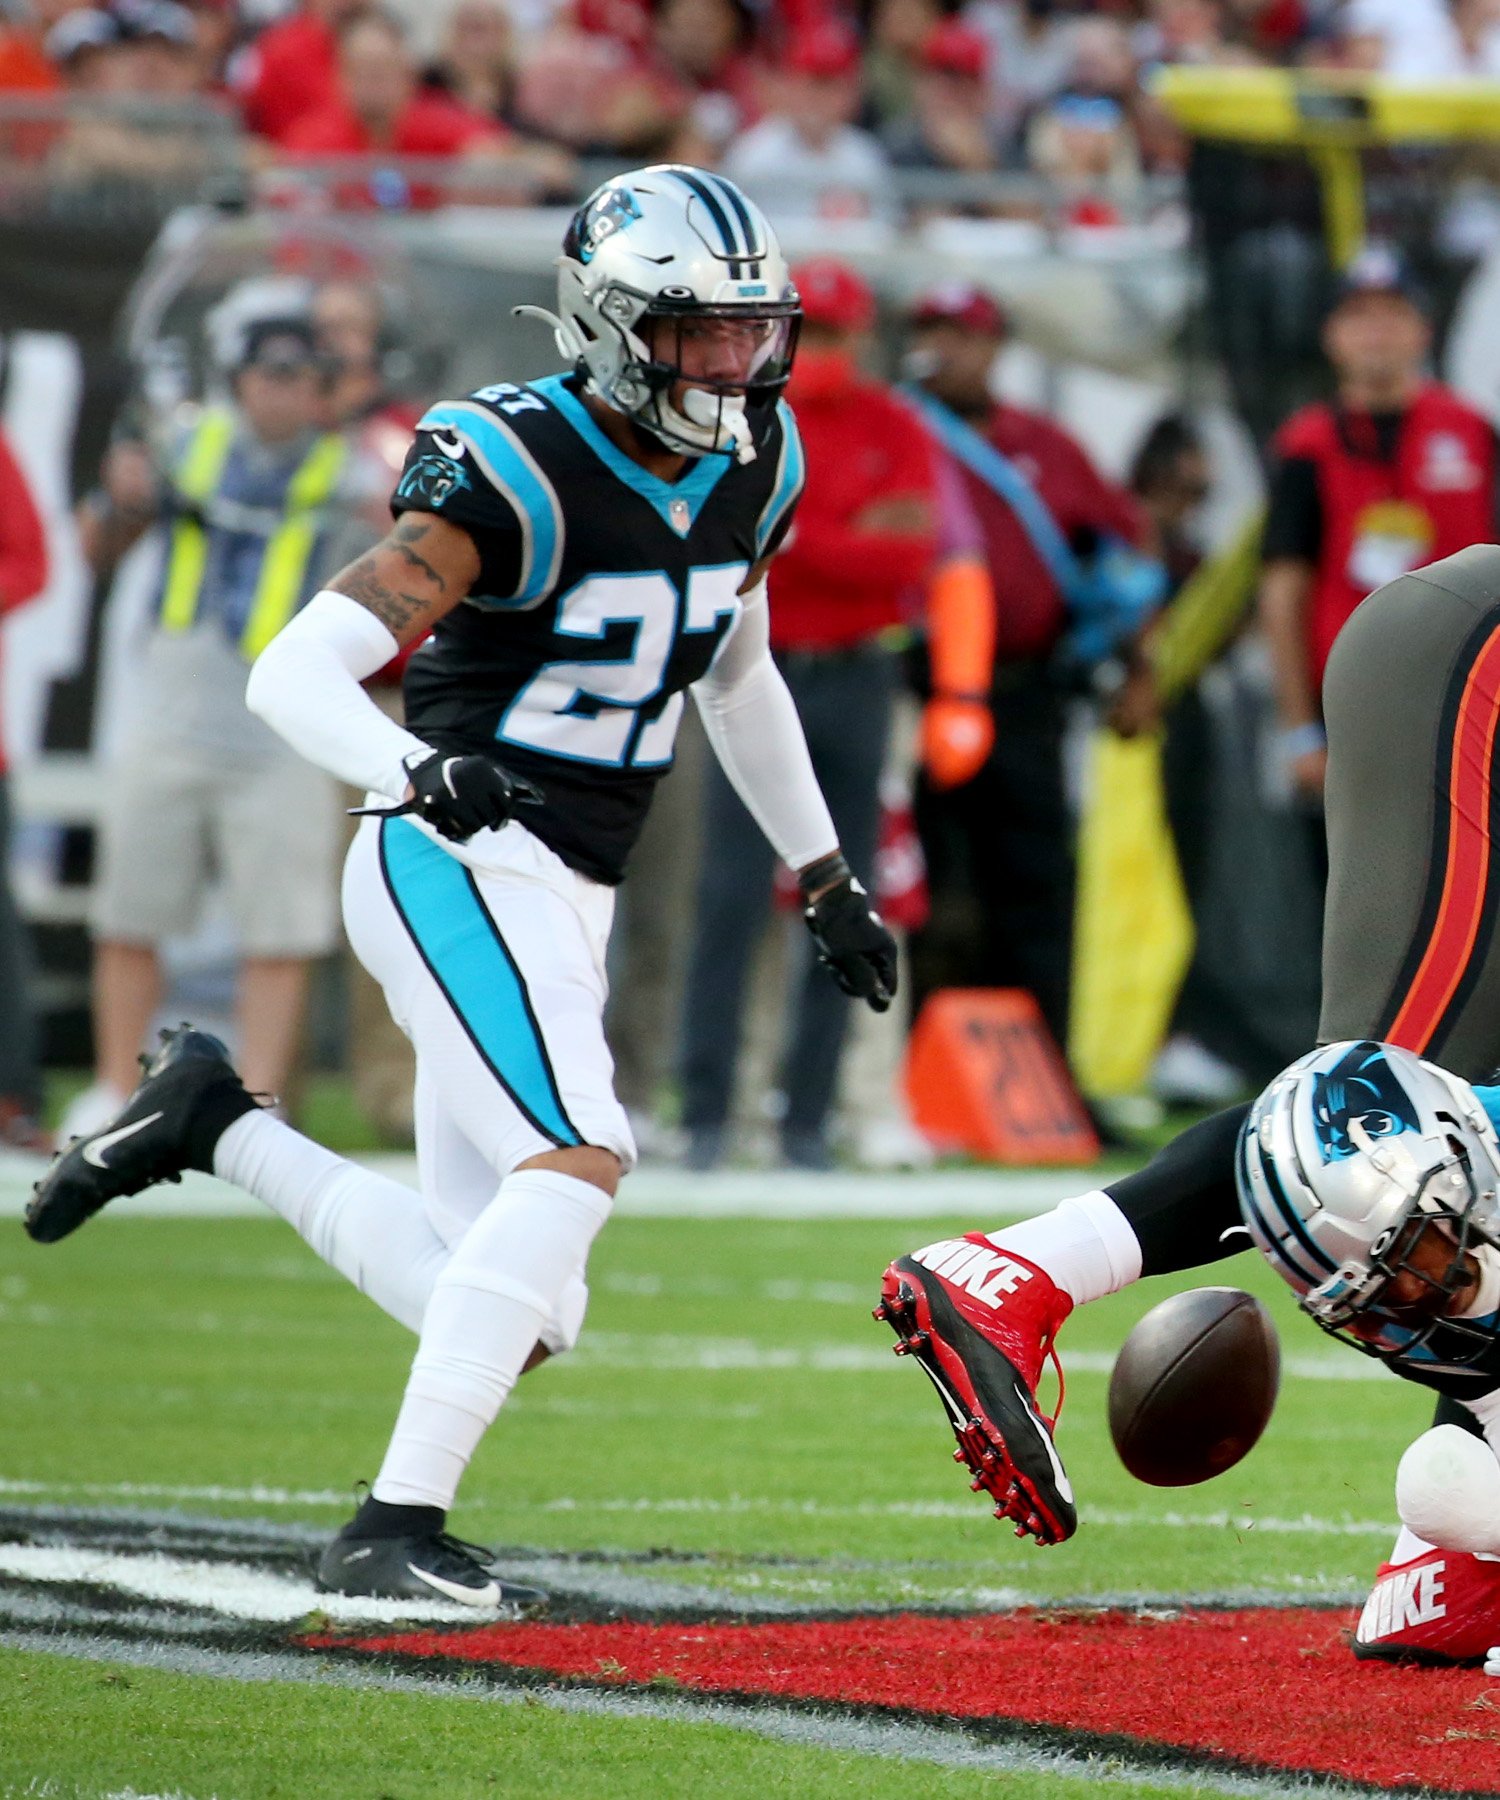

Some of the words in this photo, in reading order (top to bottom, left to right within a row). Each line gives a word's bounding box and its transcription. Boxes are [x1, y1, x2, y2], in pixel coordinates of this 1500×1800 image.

[469, 382, 548, 416] 27
[494, 560, 750, 769] 27
[910, 1240, 1034, 1310] NIKE
[1356, 1560, 1447, 1644] NIKE
